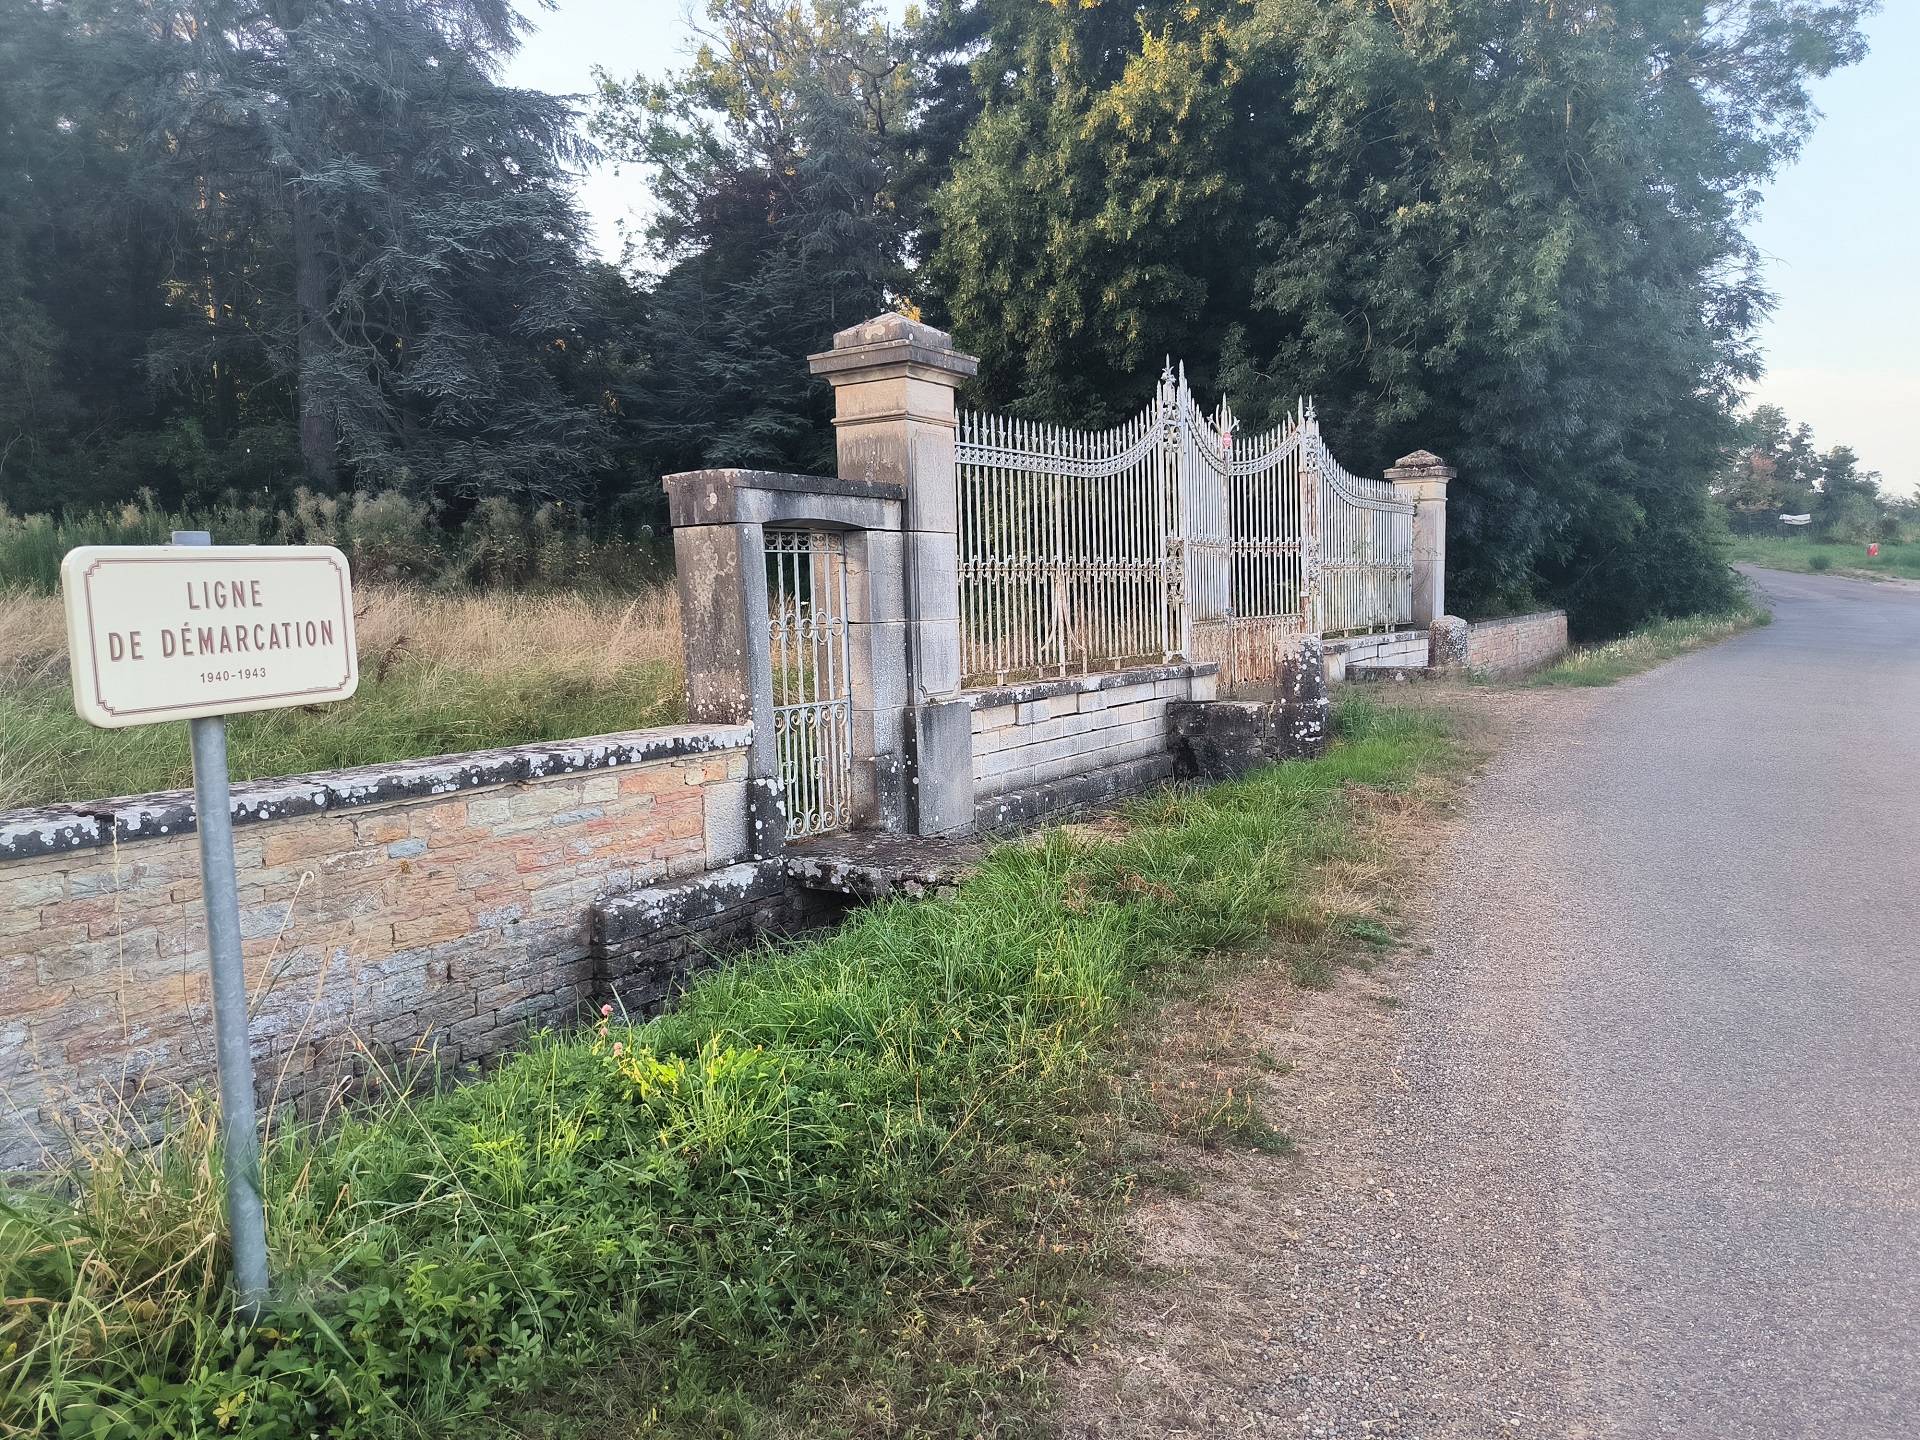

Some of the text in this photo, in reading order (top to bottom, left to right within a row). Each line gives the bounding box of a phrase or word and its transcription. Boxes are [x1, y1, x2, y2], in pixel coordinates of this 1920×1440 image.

[187, 580, 263, 610] LIGNE
[108, 620, 334, 662] DE DÉMARCATION
[200, 667, 266, 684] 1940-1943
